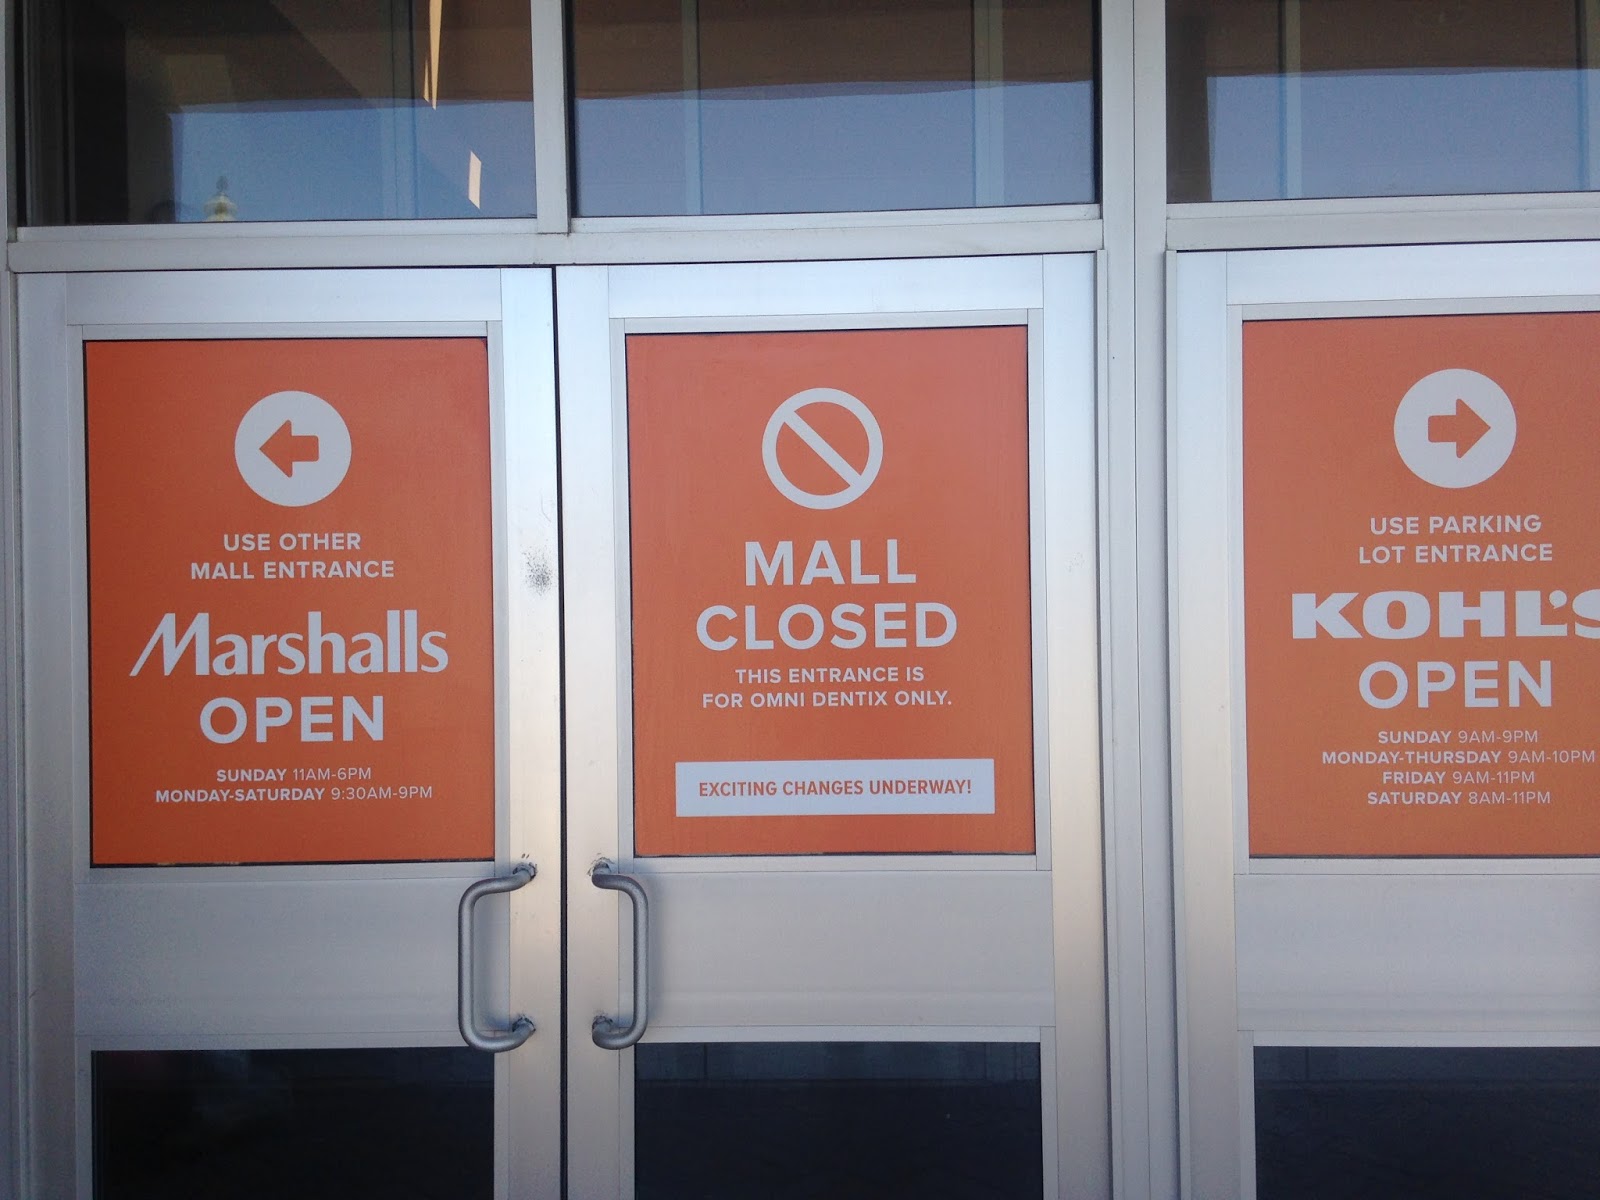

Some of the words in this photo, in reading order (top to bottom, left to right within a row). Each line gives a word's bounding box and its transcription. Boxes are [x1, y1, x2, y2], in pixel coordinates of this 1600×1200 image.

[1370, 517, 1419, 535] USE
[1429, 514, 1542, 534] PARKING
[223, 533, 271, 552] USE
[279, 532, 361, 551] OTHER
[745, 539, 917, 586] MALL
[1359, 546, 1405, 564] LOT
[1415, 543, 1553, 563] ENTRANCE
[191, 562, 254, 580] MALL
[264, 560, 395, 579] ENTRANCE
[696, 602, 957, 651] CLOSED
[129, 610, 448, 677] Marshalls
[735, 668, 781, 684] THIS
[789, 666, 899, 683] ENTRANCE
[906, 666, 924, 681] IS
[1358, 660, 1552, 709] OPEN
[702, 693, 743, 708] FOR
[750, 692, 805, 708] OMNI
[812, 691, 888, 707] DENTIX
[894, 690, 952, 706] ONLY.
[199, 696, 384, 744] OPEN
[1378, 730, 1451, 744] SUNDAY
[1458, 730, 1538, 743] 9AM-9PM
[1322, 751, 1502, 764] MONDAY-THURSDAY
[1508, 750, 1595, 764] 9AM-10PM
[216, 768, 287, 782] SUNDAY
[293, 767, 372, 781] 11AM-6PM
[1382, 771, 1446, 784] FRIDAY
[1453, 771, 1535, 784] 9AM-11PM
[156, 788, 325, 803] MONDAY-SATURDAY
[331, 786, 433, 801] 9:30AM-9PM
[699, 781, 777, 797] EXCITING
[782, 780, 863, 796] CHANGES
[870, 779, 972, 795] UNDERWAY!
[1367, 791, 1462, 805] SATURDAY
[1468, 791, 1551, 804] 8AM-11PM
